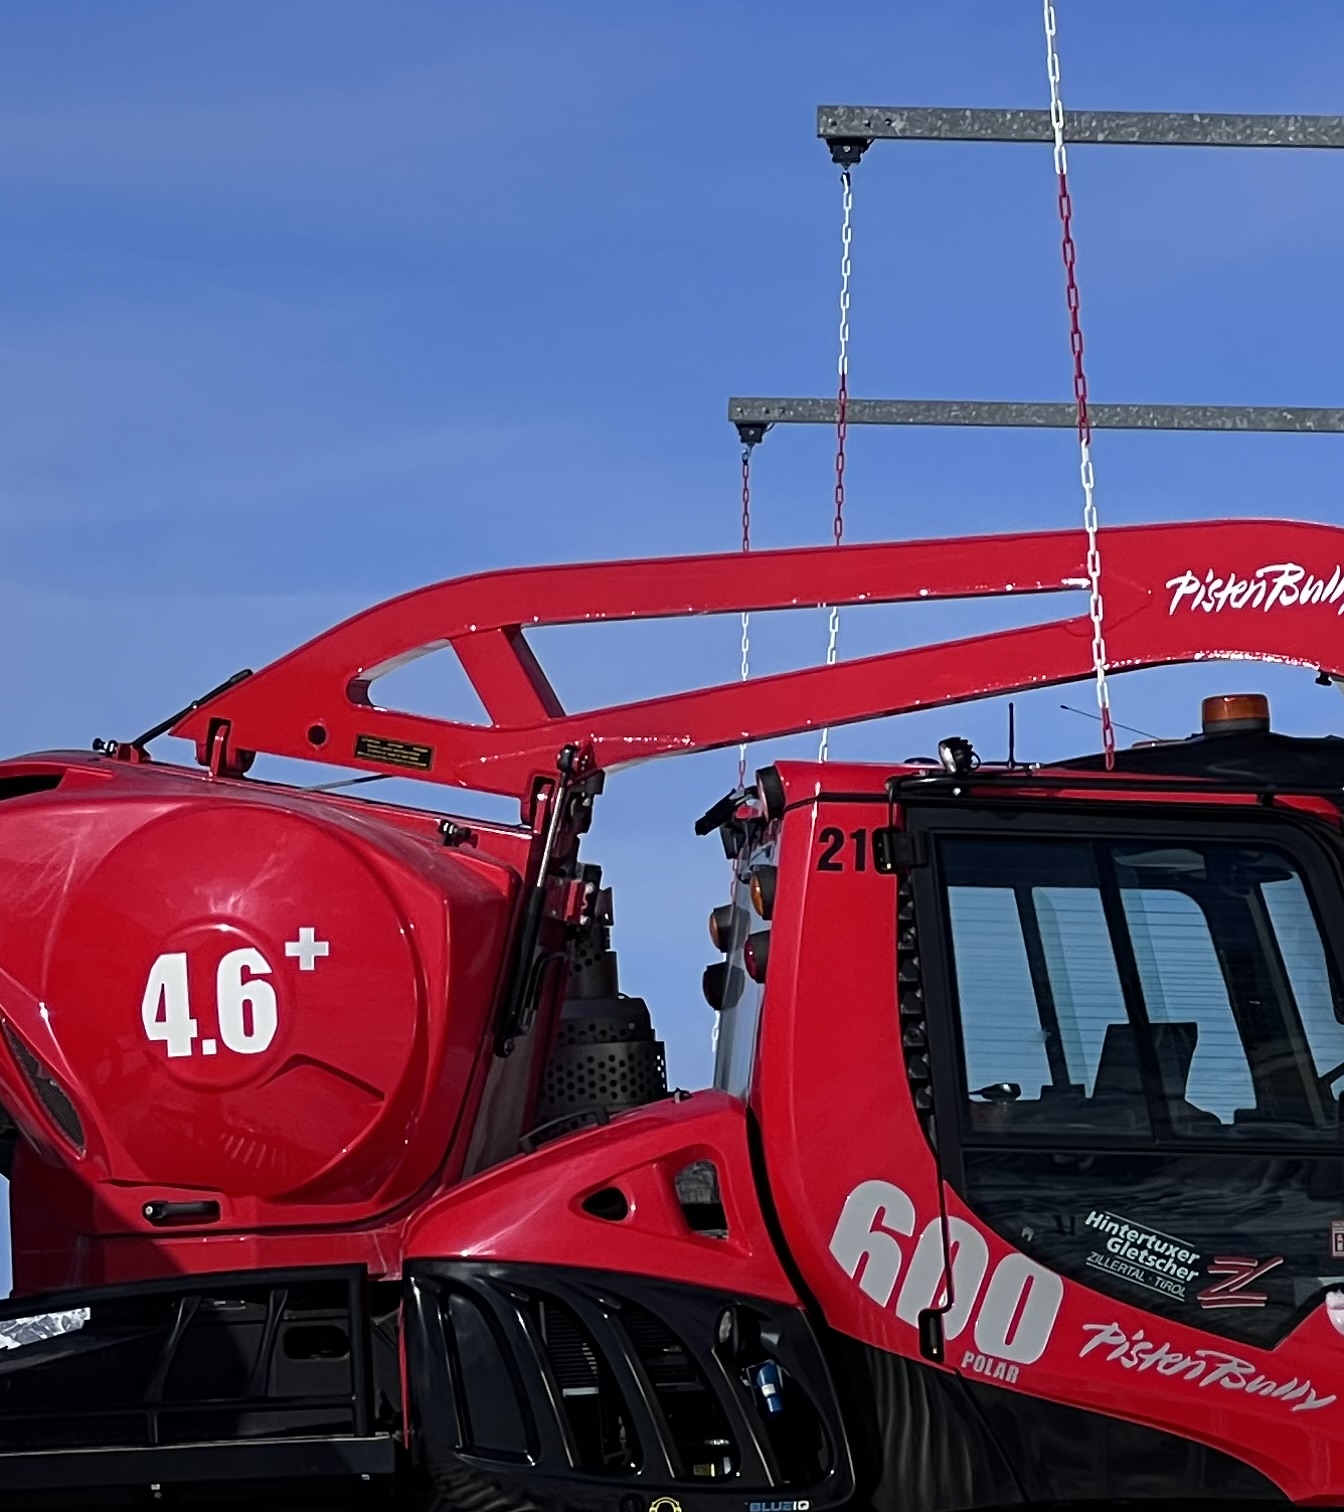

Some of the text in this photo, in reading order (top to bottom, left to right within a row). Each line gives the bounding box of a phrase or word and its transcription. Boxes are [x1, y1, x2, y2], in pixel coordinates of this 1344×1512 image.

[1085, 1210, 1200, 1265] Hintertuxer
[1106, 1237, 1199, 1281] Gletscher
[829, 1179, 1064, 1365] 600
[1086, 1250, 1145, 1282] ZILLERTAL
[960, 1350, 1020, 1384] POLAR
[1079, 1322, 1337, 1412] PistenBully
